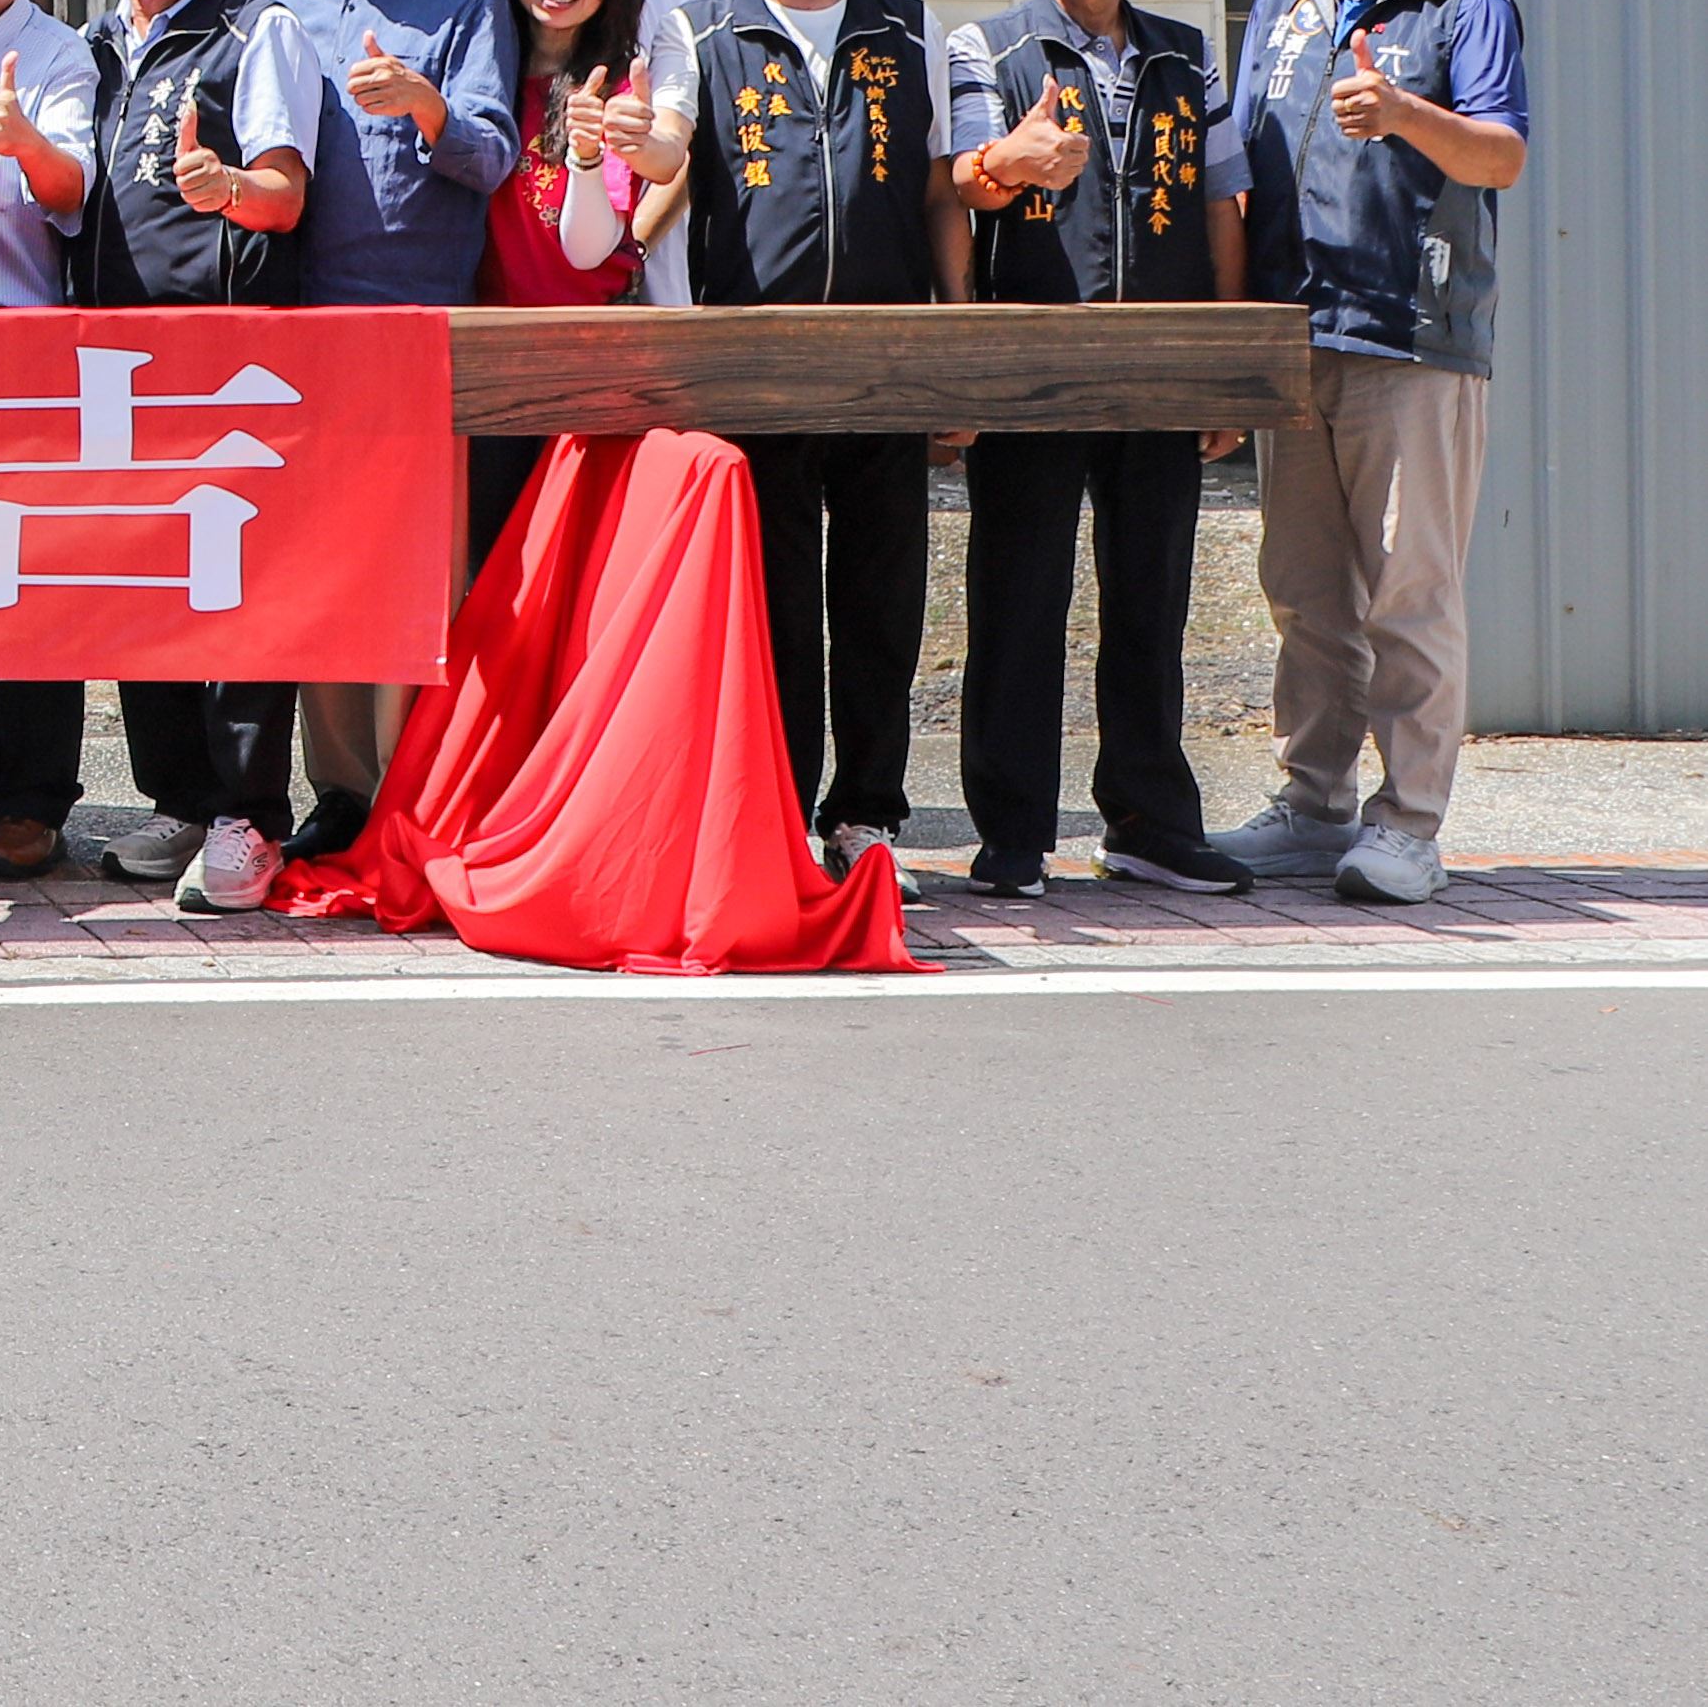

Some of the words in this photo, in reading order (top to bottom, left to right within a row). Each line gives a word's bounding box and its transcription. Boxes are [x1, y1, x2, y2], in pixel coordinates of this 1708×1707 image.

[133, 77, 175, 186] 黃金茂
[735, 86, 771, 188] 黃俊銘
[764, 62, 793, 116] 代表
